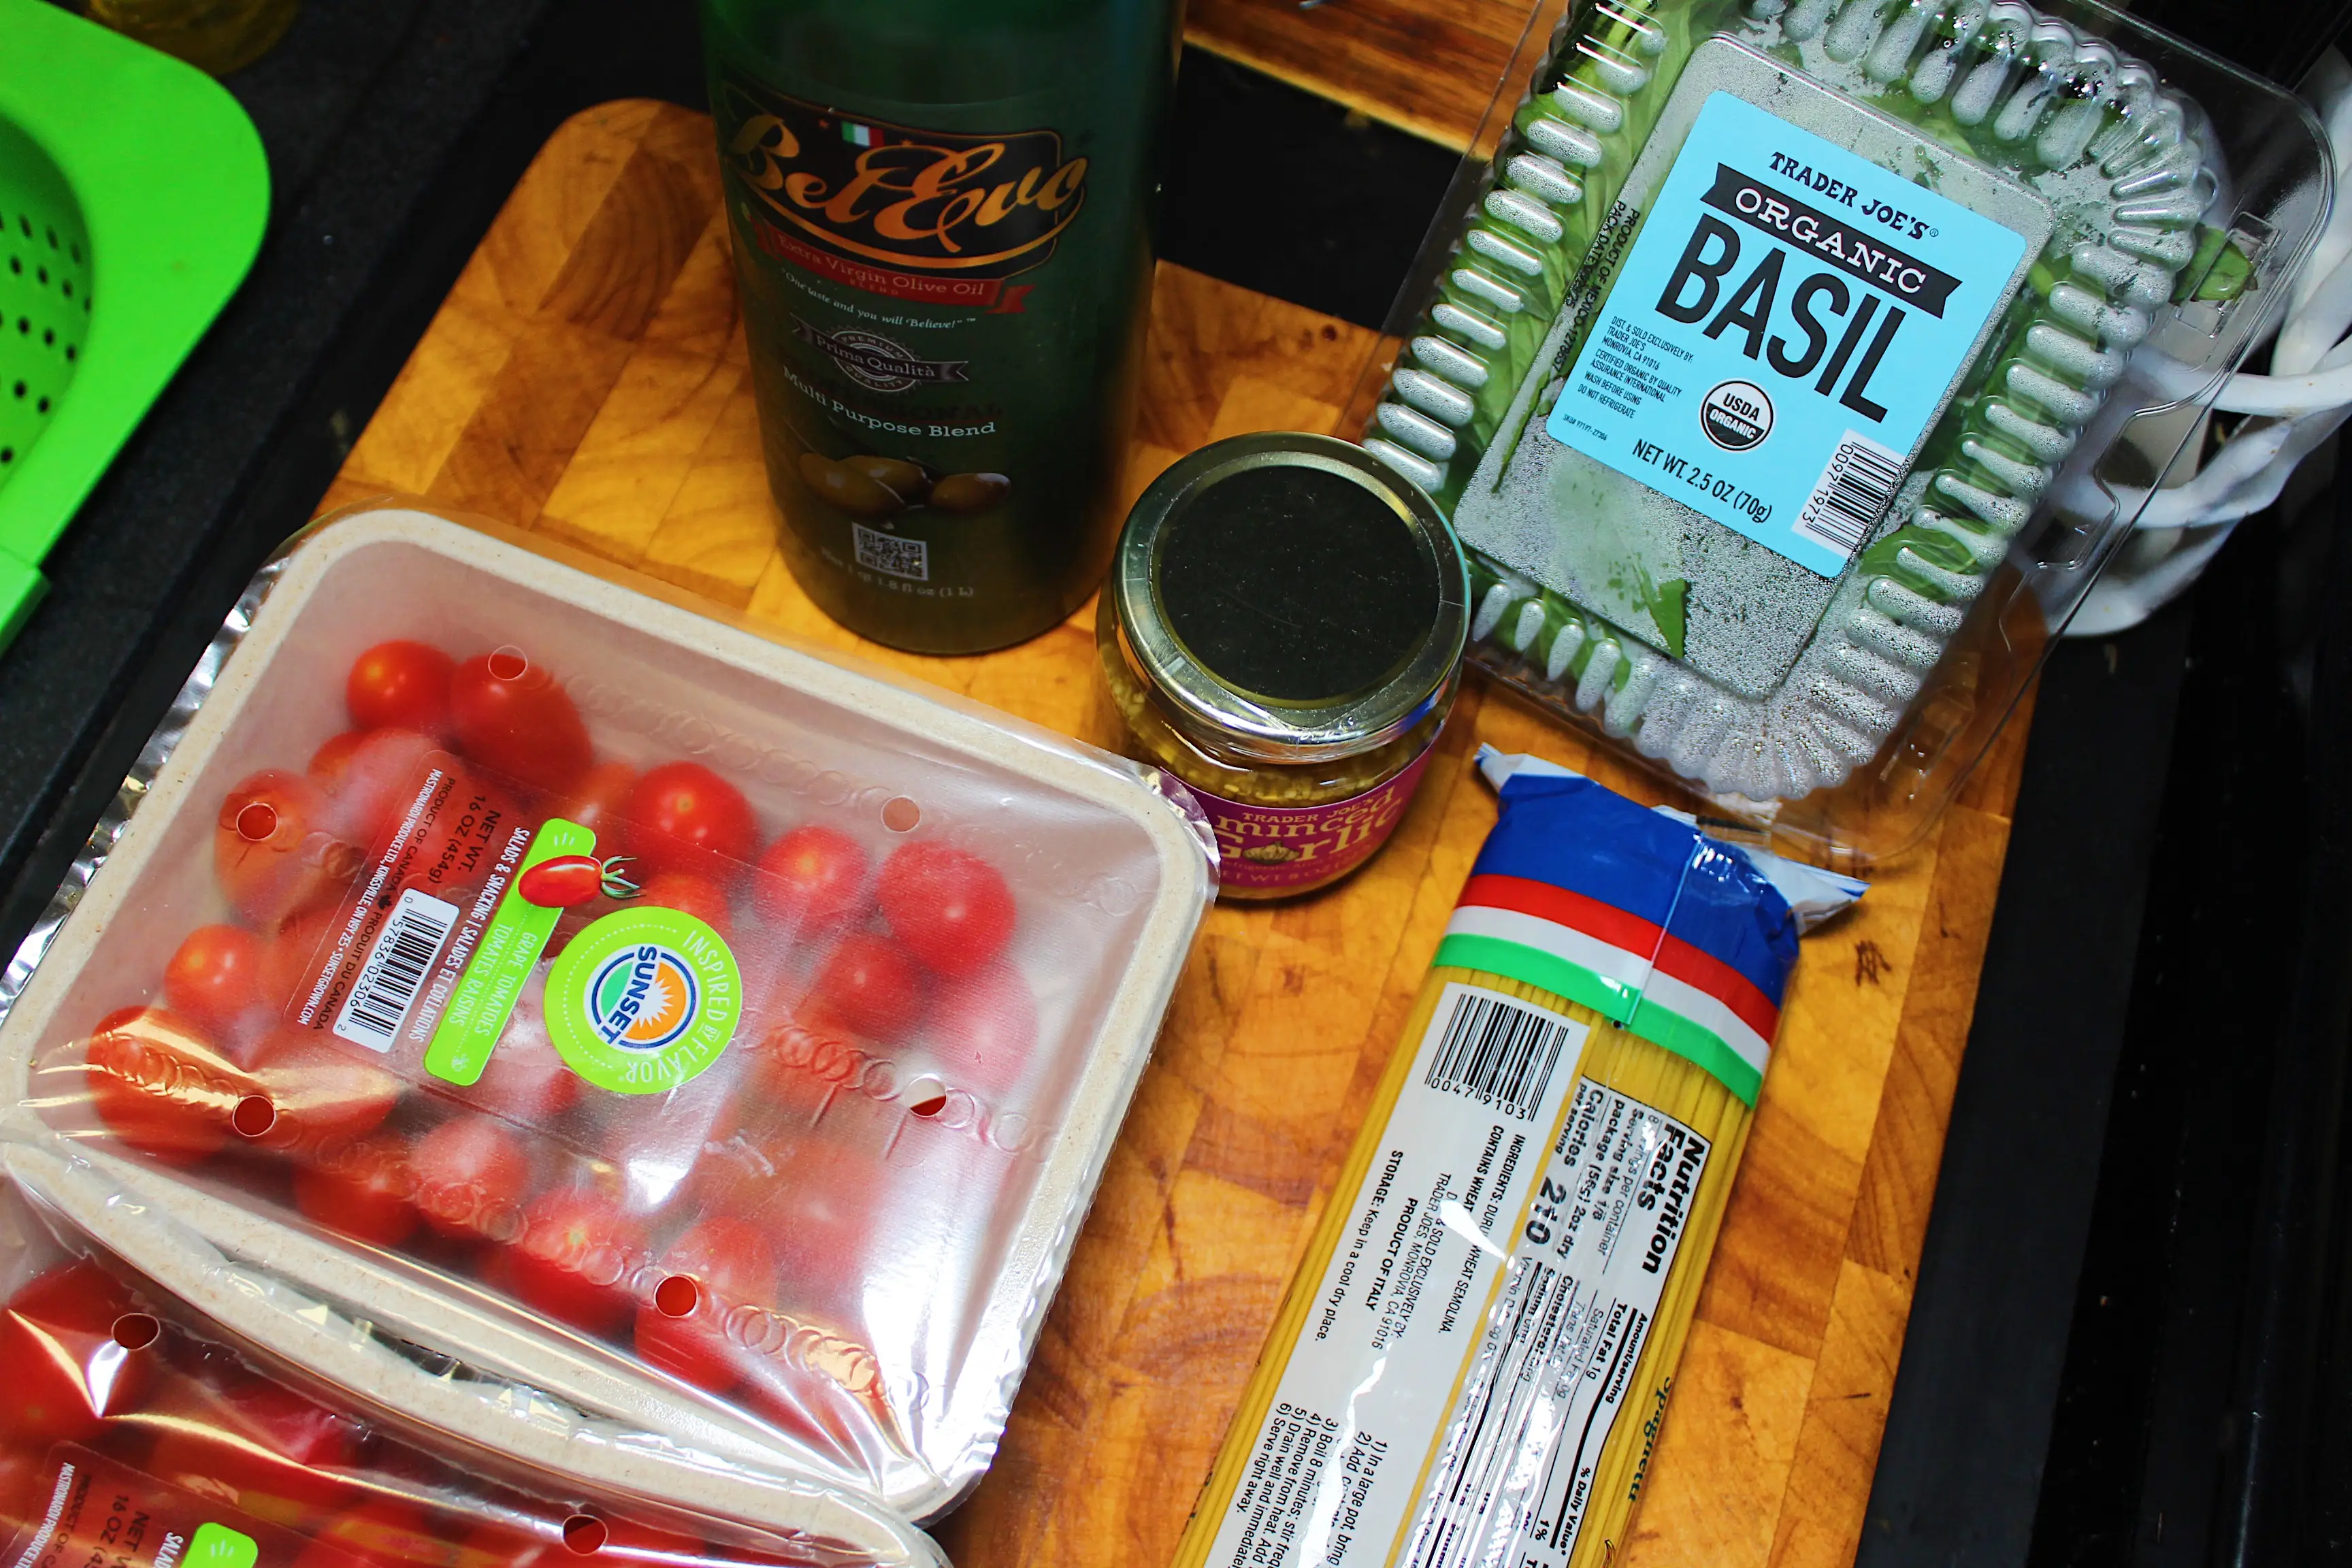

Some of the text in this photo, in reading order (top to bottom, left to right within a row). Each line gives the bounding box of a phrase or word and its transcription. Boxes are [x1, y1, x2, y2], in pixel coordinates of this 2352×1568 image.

[1769, 152, 1858, 208] TRADER
[1595, 208, 1642, 284] PRODUCT OF
[1601, 199, 1627, 235] PACK
[1735, 187, 1927, 295] ORGANIC
[779, 235, 983, 295] Extra Virgin Olive Oil
[807, 286, 902, 326] taste and you will
[1606, 325, 1629, 343] TRADER
[1654, 212, 1906, 423] BASIL
[816, 334, 935, 378] Prima Qualità
[1595, 348, 1682, 397] CERTIFIED ORGANIC BY QUALITY
[1601, 336, 1661, 370] MONROVIA, CA 91016
[1631, 326, 1695, 363] SOLD EXCLUSIVELY BY:
[784, 365, 828, 406] Multi
[832, 399, 921, 436] Purpose
[928, 422, 996, 438] Blend
[1577, 383, 1636, 419] DO NOT REFRIGERATE
[1583, 371, 1642, 406] WASH BEFORE USING
[1589, 357, 1667, 403] ASSURANCE INTERNATIONAL
[1723, 393, 1760, 421] USDA
[1709, 408, 1757, 440] ORGANIC
[1631, 437, 1774, 527] NET WT. 2.5 OZ (70g)
[1800, 442, 1855, 525] 0097 1973
[385, 774, 456, 895] PRODUCT OF CANADA
[427, 791, 487, 887] 16 OZ (454g)
[1215, 785, 1394, 837] minced
[1243, 812, 1318, 823] TRADER
[456, 808, 501, 876] NET WT.
[296, 766, 442, 1026] MASTRONARDI PRODUCE KINGSVILLE, ON N9Y 2E5 SUNSETGROWN.COM
[406, 824, 531, 1044] SALADS & SNACKING SALADES ET COLLATIONS
[312, 909, 383, 1034] PRODUIT DU CANADA
[348, 917, 404, 1011] 57836 02306
[447, 919, 514, 1028] TOMATES RAISINS
[472, 929, 538, 1038] GRAPE TOMATOES
[682, 930, 730, 1022] INSPIRED
[601, 945, 657, 1045] SUNSET
[625, 1034, 708, 1083] FLAVOR
[1430, 1073, 1527, 1121] 0047 9103
[1474, 1124, 1506, 1176] CONTAINS
[1612, 1108, 1644, 1163] Serving
[1425, 1171, 1452, 1212] TRADER
[1487, 1132, 1528, 1205] INGREDIENTS:
[1524, 1088, 1604, 1244] Calories 210
[1554, 1099, 1627, 1260] package 2oz dry
[1637, 1123, 1688, 1211] Facts
[1595, 1175, 1635, 1256] per container
[1642, 1136, 1708, 1274] Nutrition
[1312, 1148, 1405, 1345] STORAGE: Keep in cool dry place.
[1362, 1196, 1420, 1311] PRODUCT OF ITALY
[1389, 1241, 1424, 1301] MONROVIA,
[1383, 1299, 1400, 1317] CA
[1390, 1227, 1443, 1339] SOLD EXCLUSIVELY BY:
[1436, 1279, 1470, 1337] SEMOLINA.
[1369, 1316, 1394, 1351] 91016
[1605, 1313, 1649, 1405] Amount/serving
[1312, 1432, 1333, 1458] Boil
[1320, 1416, 1339, 1433] 3)
[1535, 1301, 1628, 1540] Total Fat 1g 1%
[1233, 1400, 1292, 1516] 6) Serve right away.
[1258, 1405, 1307, 1504] 5) Drain well and
[1344, 1446, 1367, 1473] Add
[1367, 1453, 1383, 1468] In
[45, 1462, 76, 1523] MASTRONARDI
[1250, 1410, 1323, 1565] 4) Remove from heat. Add
[1286, 1467, 1320, 1521] minutes;
[1348, 1475, 1374, 1509] large
[1570, 1480, 1586, 1512] Daily
[99, 1516, 124, 1547] OZ
[125, 1510, 152, 1553] NET
[1277, 1520, 1298, 1544] stir
[1325, 1532, 1352, 1567] bring
[1337, 1507, 1362, 1535] pot,
